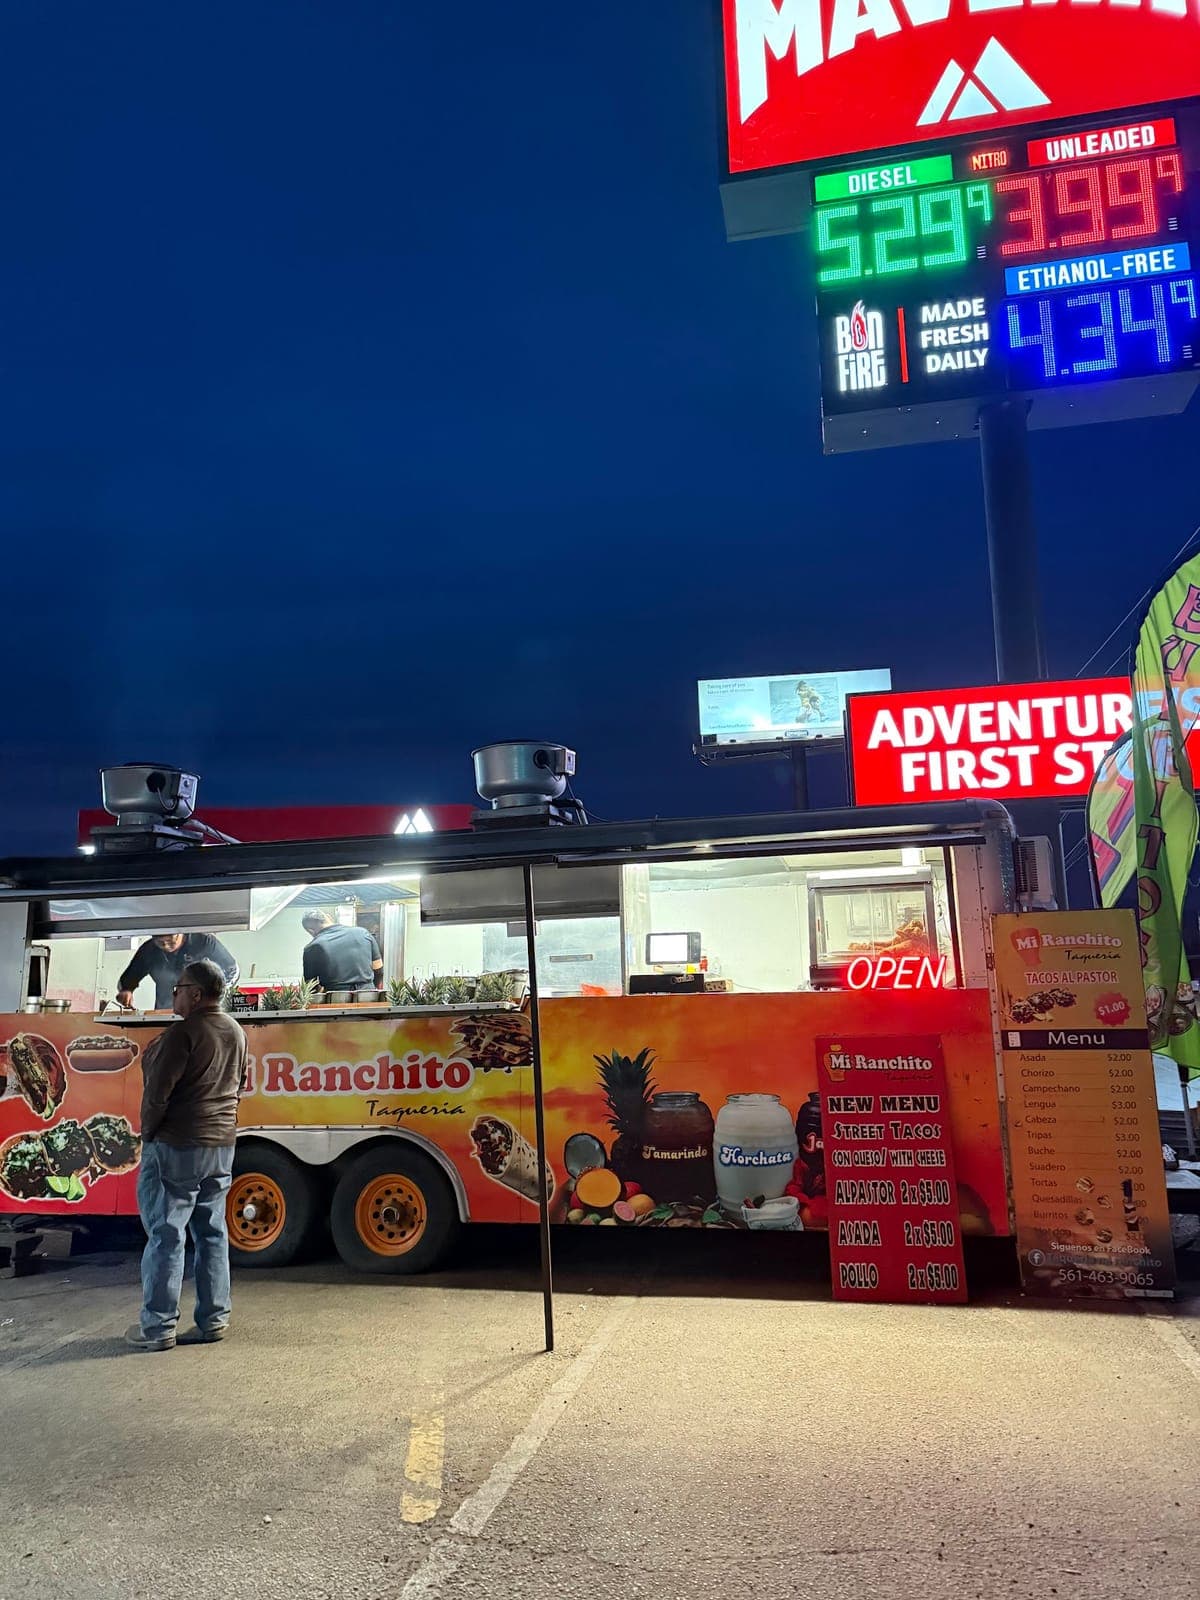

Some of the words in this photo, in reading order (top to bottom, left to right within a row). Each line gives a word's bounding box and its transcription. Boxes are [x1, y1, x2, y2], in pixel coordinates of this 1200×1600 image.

[1046, 125, 1155, 161] UNLEADED
[972, 150, 1007, 171] NITRO
[849, 165, 917, 194] DIESEL
[1017, 249, 1177, 291] ETHANOL-FREE
[922, 298, 986, 323] MADE
[920, 323, 989, 348] FRESH
[926, 348, 989, 373] DAILY
[901, 745, 1040, 793] FIRST
[1016, 935, 1038, 950] Mi
[1041, 932, 1123, 948] Ranchito
[847, 956, 947, 989] OPEN
[1026, 971, 1059, 984] TACOS
[1061, 972, 1075, 983] AL
[1077, 971, 1118, 983] PASTOR
[233, 996, 246, 1004] WE
[1098, 1000, 1125, 1016] $1.00
[1048, 1031, 1105, 1046] Menu
[830, 1054, 851, 1069] Mi
[855, 1054, 933, 1070] Ranchito
[1020, 1054, 1046, 1062] Asada
[1107, 1053, 1132, 1062] $2.00
[264, 1053, 472, 1093] Ranchito
[1021, 1068, 1055, 1077] Chorizo
[1108, 1069, 1133, 1078] $2.00
[1022, 1085, 1081, 1095] Campechano
[1110, 1084, 1135, 1093] $2.00
[366, 1100, 466, 1122] Taqueria
[827, 1095, 874, 1114] NEW
[880, 1095, 940, 1113] MENU
[1024, 1100, 1056, 1110] Lengua
[1111, 1101, 1137, 1110] $3.00
[1025, 1115, 1057, 1124] Cabeza
[1113, 1117, 1138, 1126] $2.00
[831, 1121, 885, 1140] STREET
[889, 1120, 941, 1140] TACOS
[1027, 1130, 1053, 1140] Tripas
[642, 1146, 708, 1160] Tamarindo
[720, 1145, 793, 1167] Horchata
[832, 1149, 852, 1167] CON
[890, 1149, 914, 1167] WITH
[915, 1149, 946, 1167] CHEESE
[1027, 1146, 1056, 1155] Buche
[1116, 1149, 1142, 1158] $2.00
[1029, 1162, 1066, 1172] Suadero
[1118, 1166, 1143, 1175] $2.00
[1031, 1178, 1058, 1187] Tortas
[919, 1178, 950, 1206] $5.00
[838, 1220, 881, 1246] ASADA
[923, 1219, 954, 1248] $5.00
[840, 1262, 879, 1289] POLLO
[927, 1261, 959, 1291] $5.00
[1058, 1269, 1155, 1286] 561-463-9065
